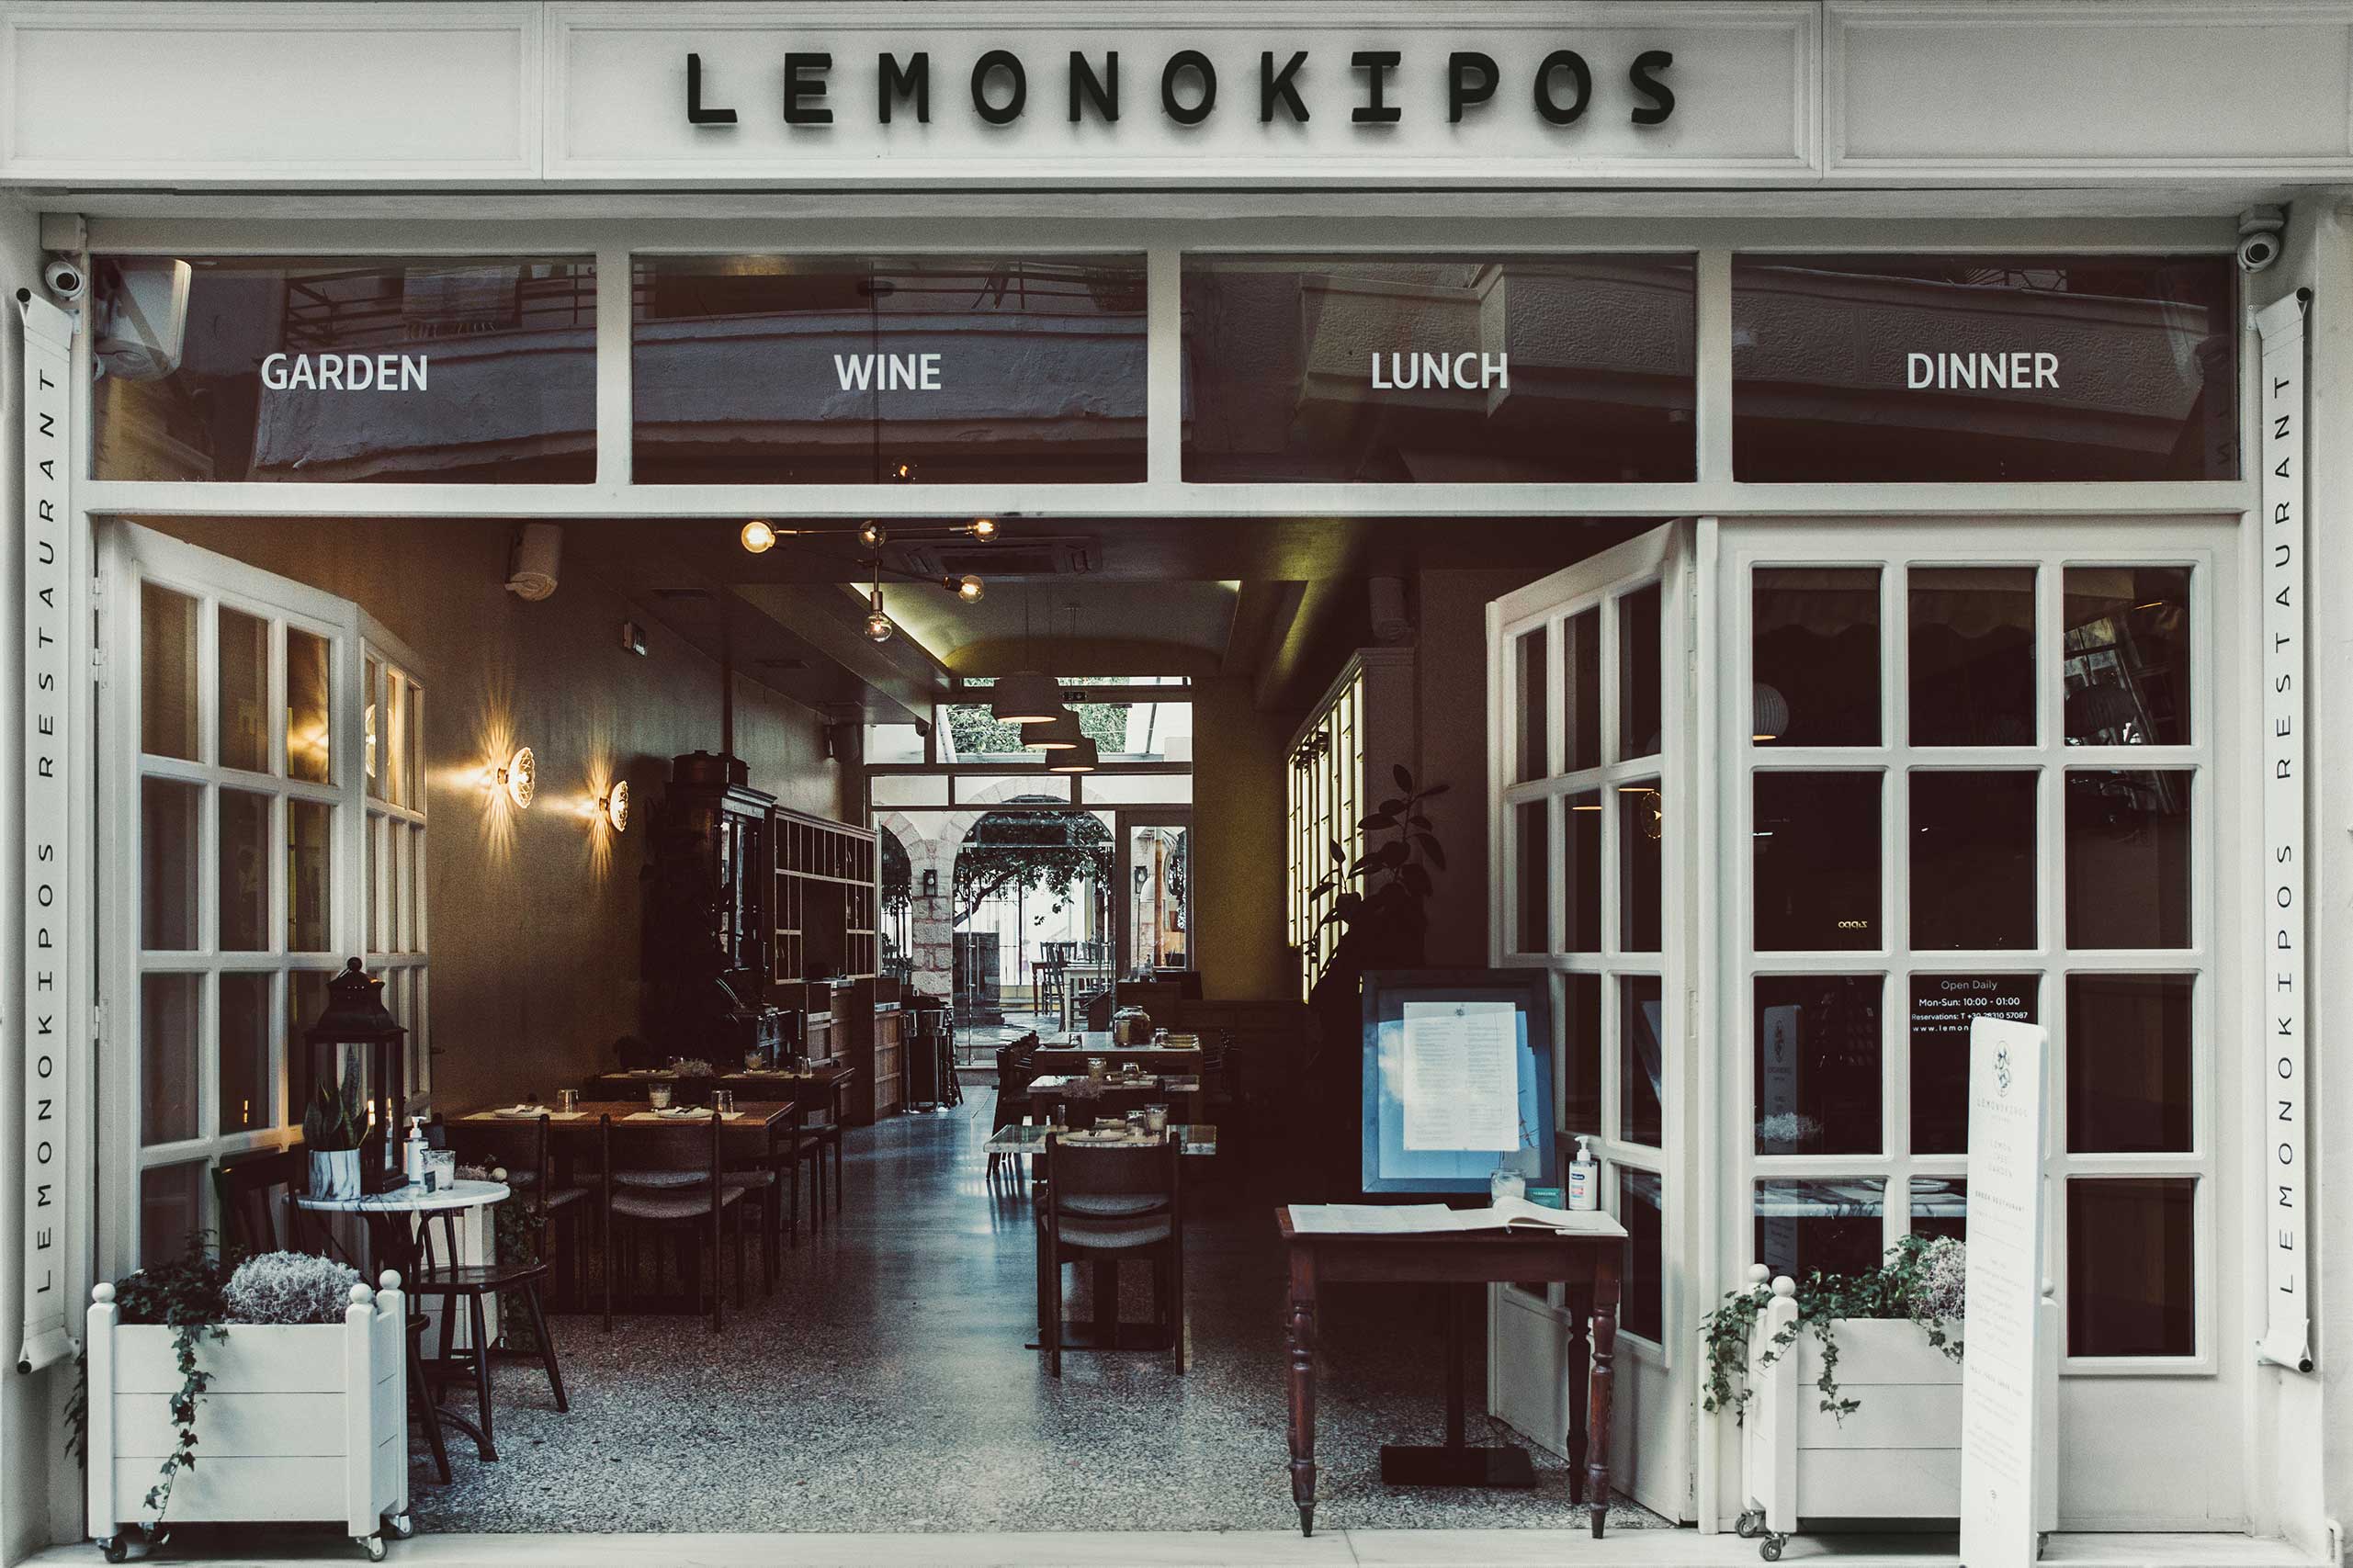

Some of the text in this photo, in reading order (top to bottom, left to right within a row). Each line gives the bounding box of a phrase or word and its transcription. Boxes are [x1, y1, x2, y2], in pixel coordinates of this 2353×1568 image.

[687, 50, 1675, 125] LEMONOKIPOS
[261, 353, 427, 391] GARDEN
[833, 354, 942, 390] WINE
[1372, 352, 1508, 389] LUNCH
[1907, 353, 2060, 389] DINNER
[37, 368, 55, 1293] LEMONOKIPOS RESTAURANT
[2274, 377, 2293, 1293] LEMONOKIPOS RESTAURANT
[1918, 998, 1961, 1007] Mon-Sun:
[1963, 998, 1987, 1006] 10:00
[1996, 997, 2020, 1006] 01:00
[1940, 979, 1998, 992] Open Daily
[2006, 1011, 2029, 1020] 57087
